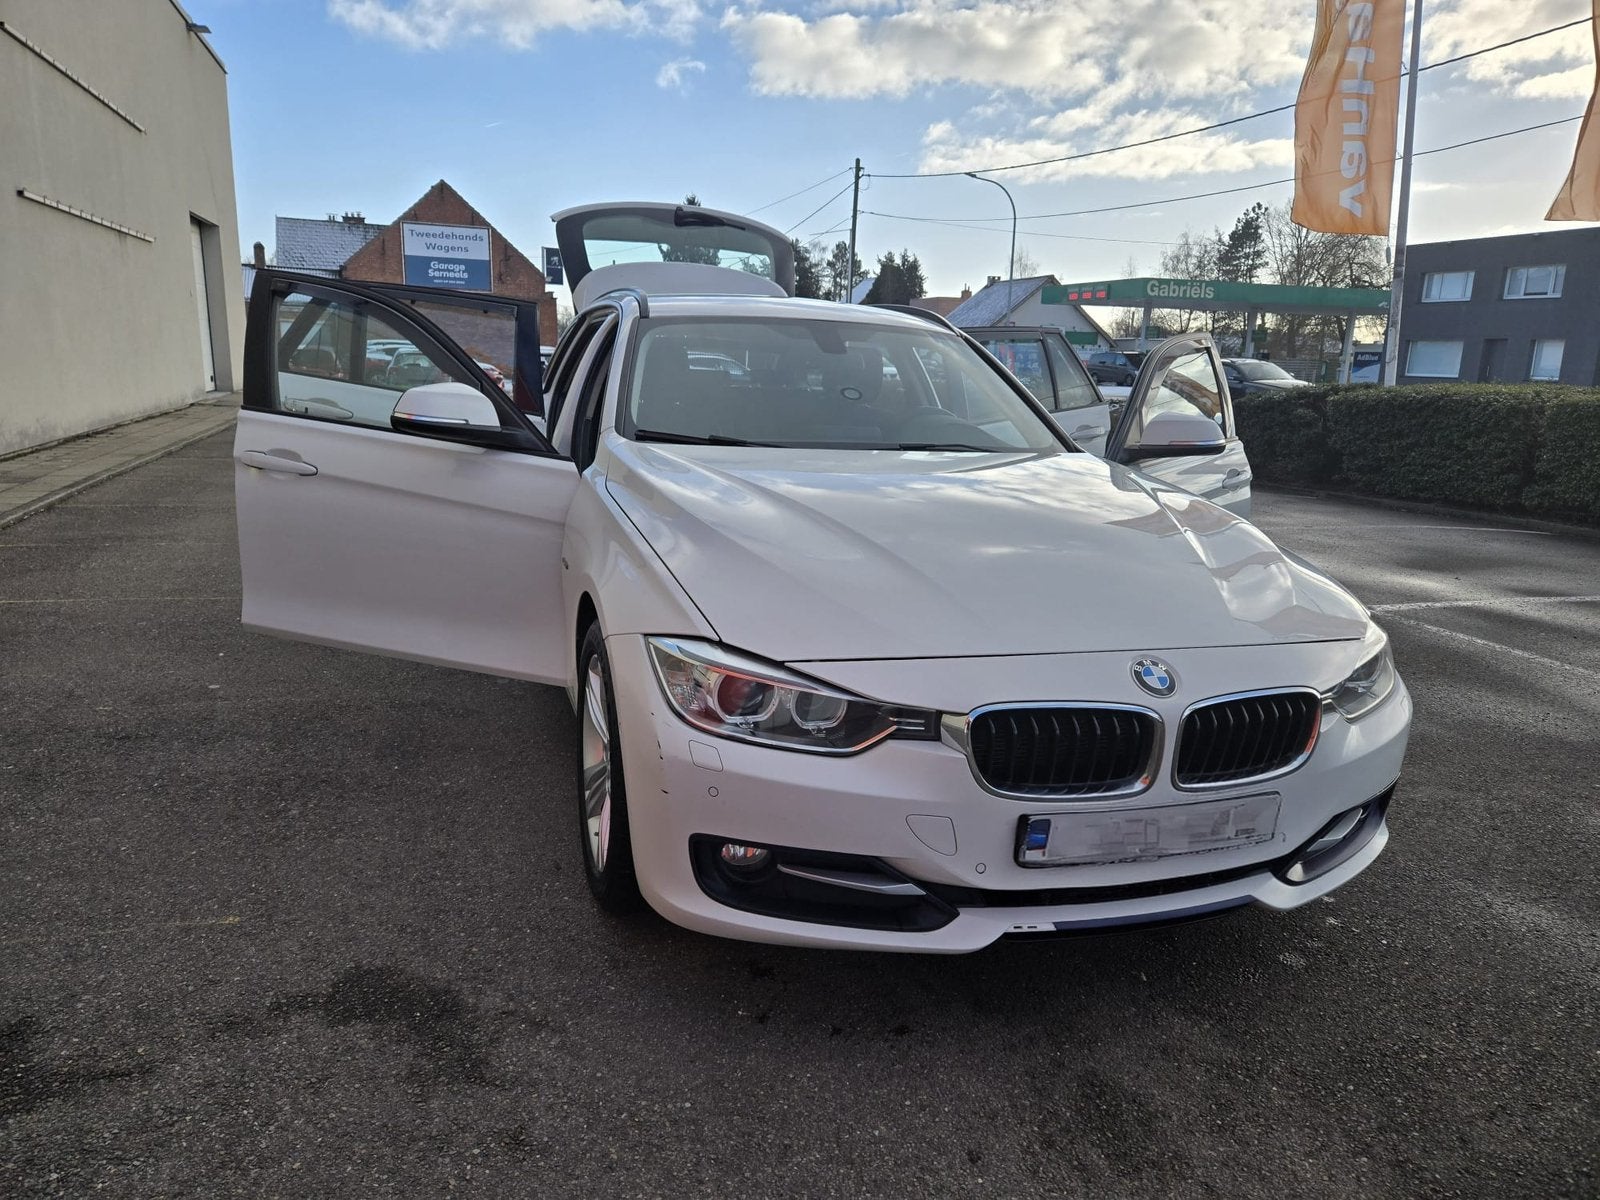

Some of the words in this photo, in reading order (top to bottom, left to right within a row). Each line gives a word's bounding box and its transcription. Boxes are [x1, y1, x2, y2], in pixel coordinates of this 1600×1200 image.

[409, 229, 484, 242] Tweedehands
[425, 242, 469, 253] Wagens
[430, 261, 466, 272] Garage
[1147, 280, 1214, 298] Gabriëls
[1134, 659, 1167, 671] BMW
